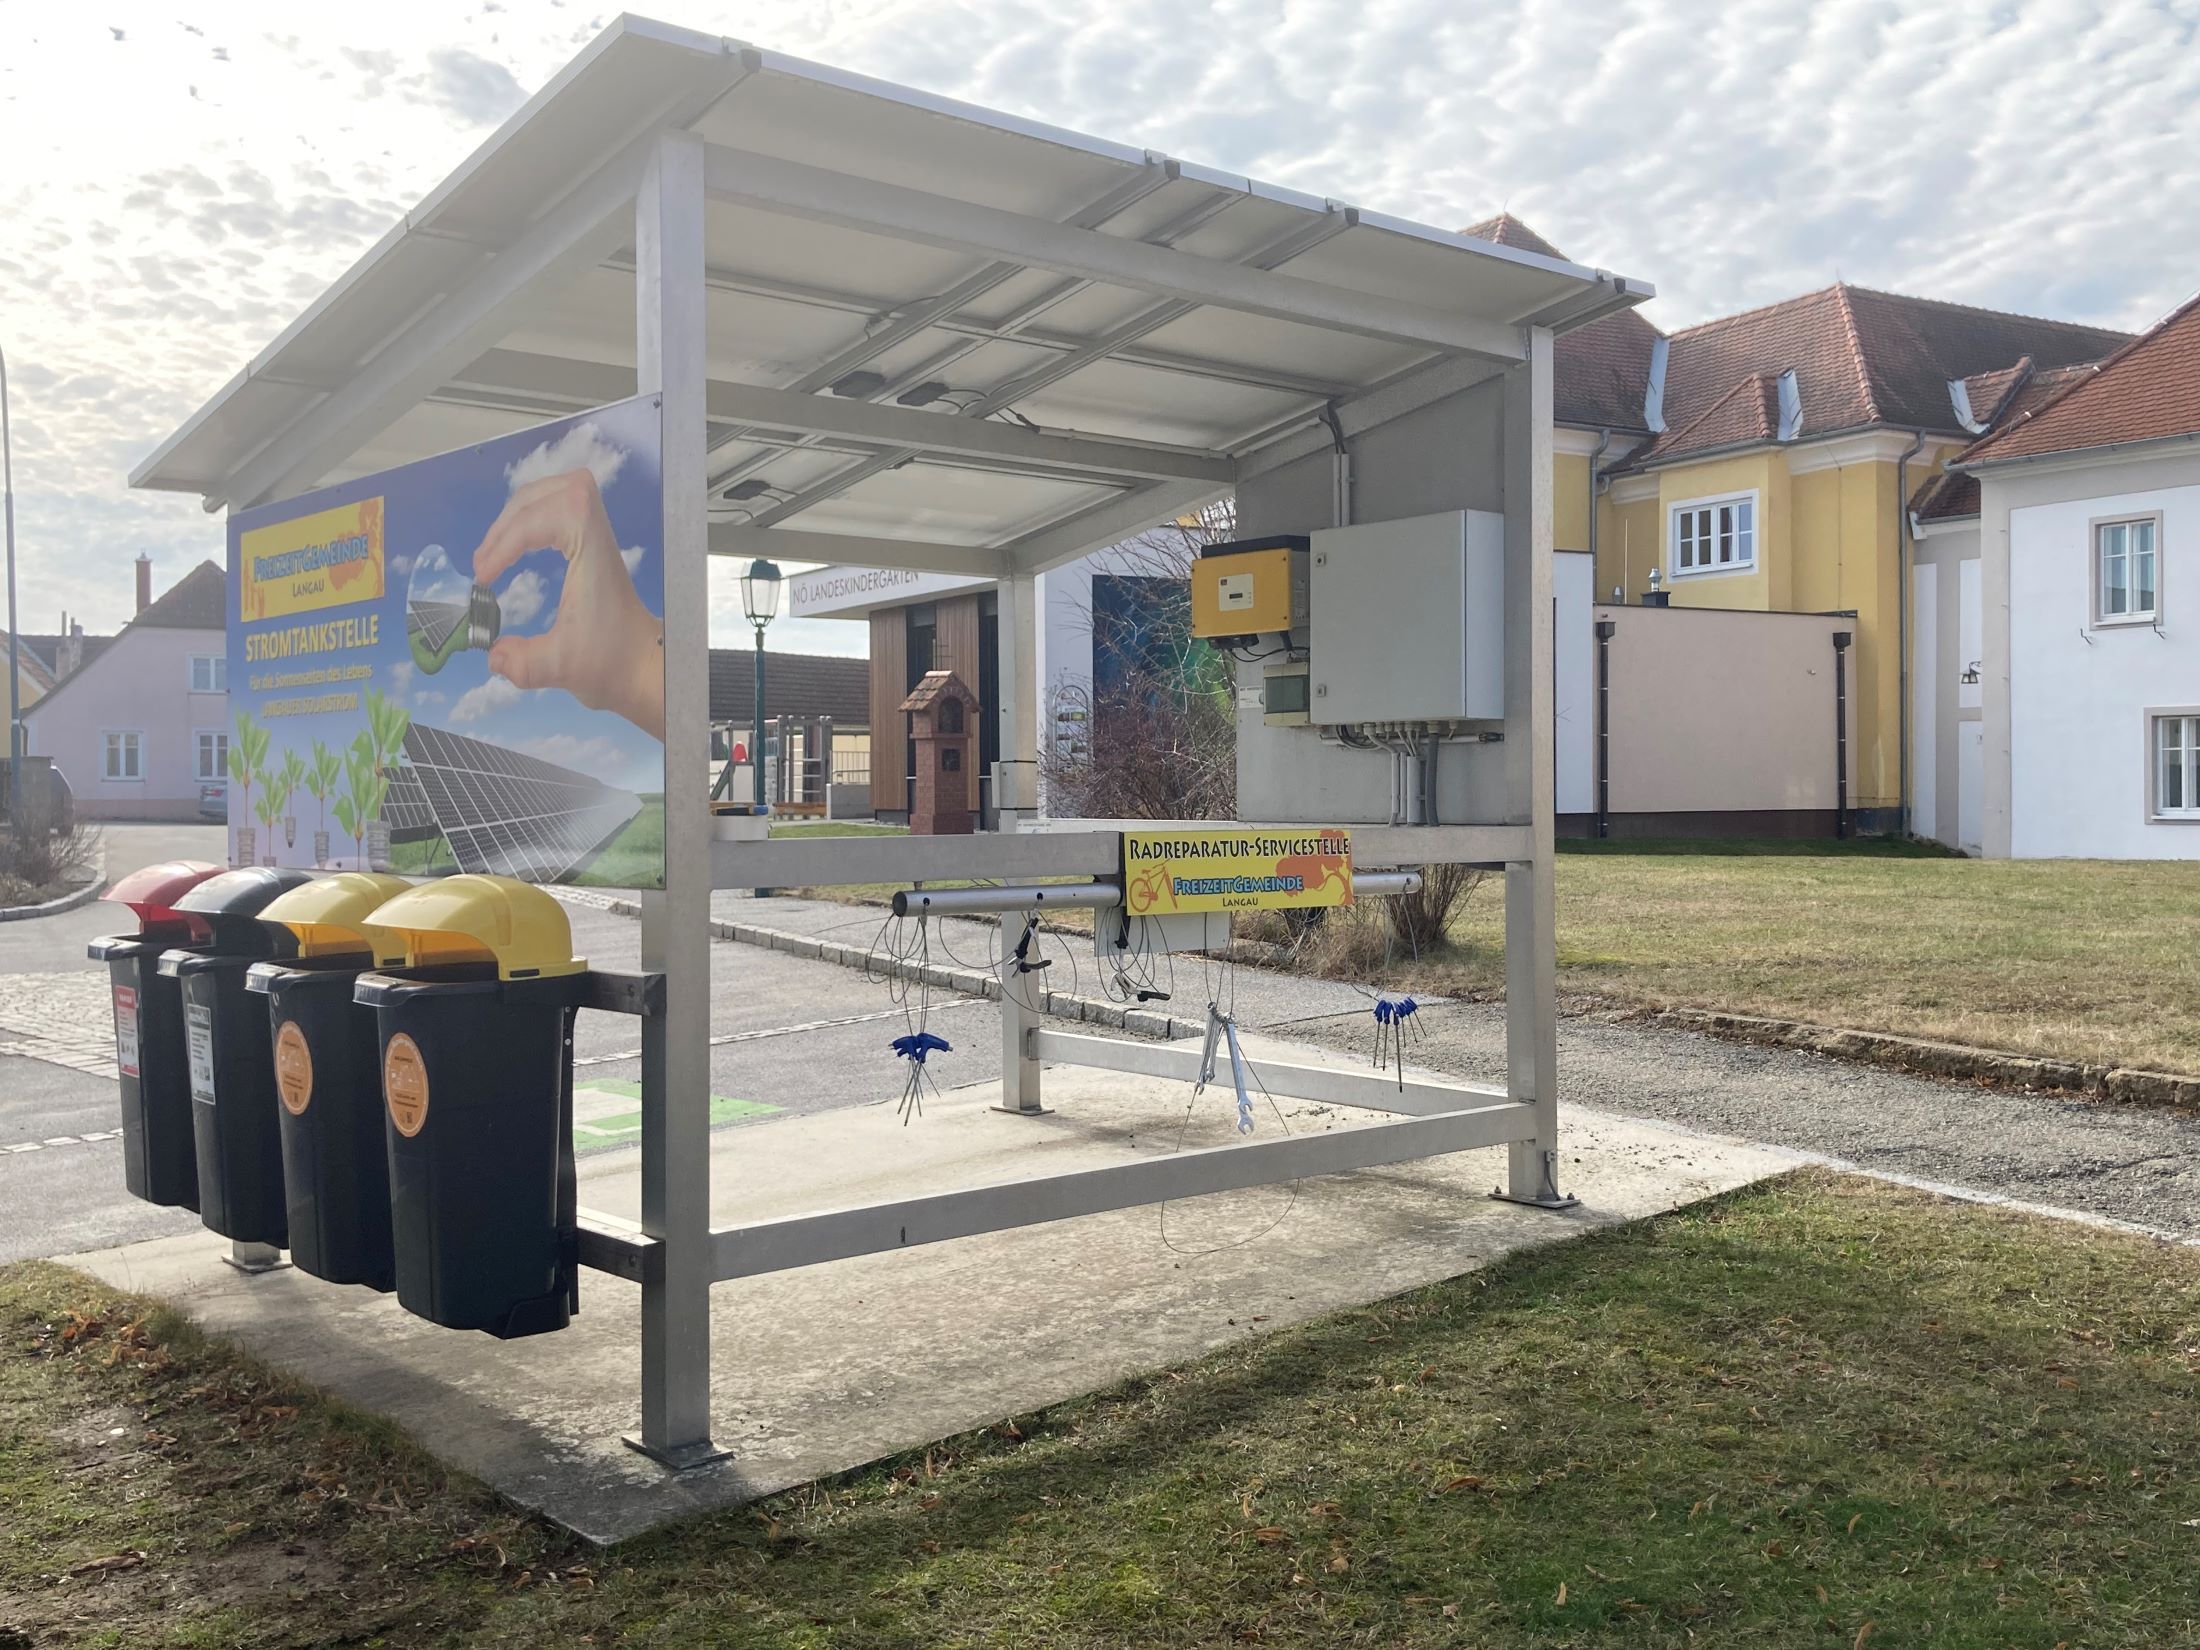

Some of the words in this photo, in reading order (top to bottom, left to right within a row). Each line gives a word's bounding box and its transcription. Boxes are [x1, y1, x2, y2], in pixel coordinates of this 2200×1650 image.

[292, 578, 324, 597] LANGAU
[793, 583, 808, 604] NÖ
[245, 614, 379, 662] STROMTANKSTELLE
[343, 662, 373, 680] Lebens
[1130, 837, 1349, 859] RADREPARATUR-SERVICESTELLE
[1173, 876, 1304, 895] FREIZEITGEMEINDE
[1222, 897, 1258, 907] LANGAU
